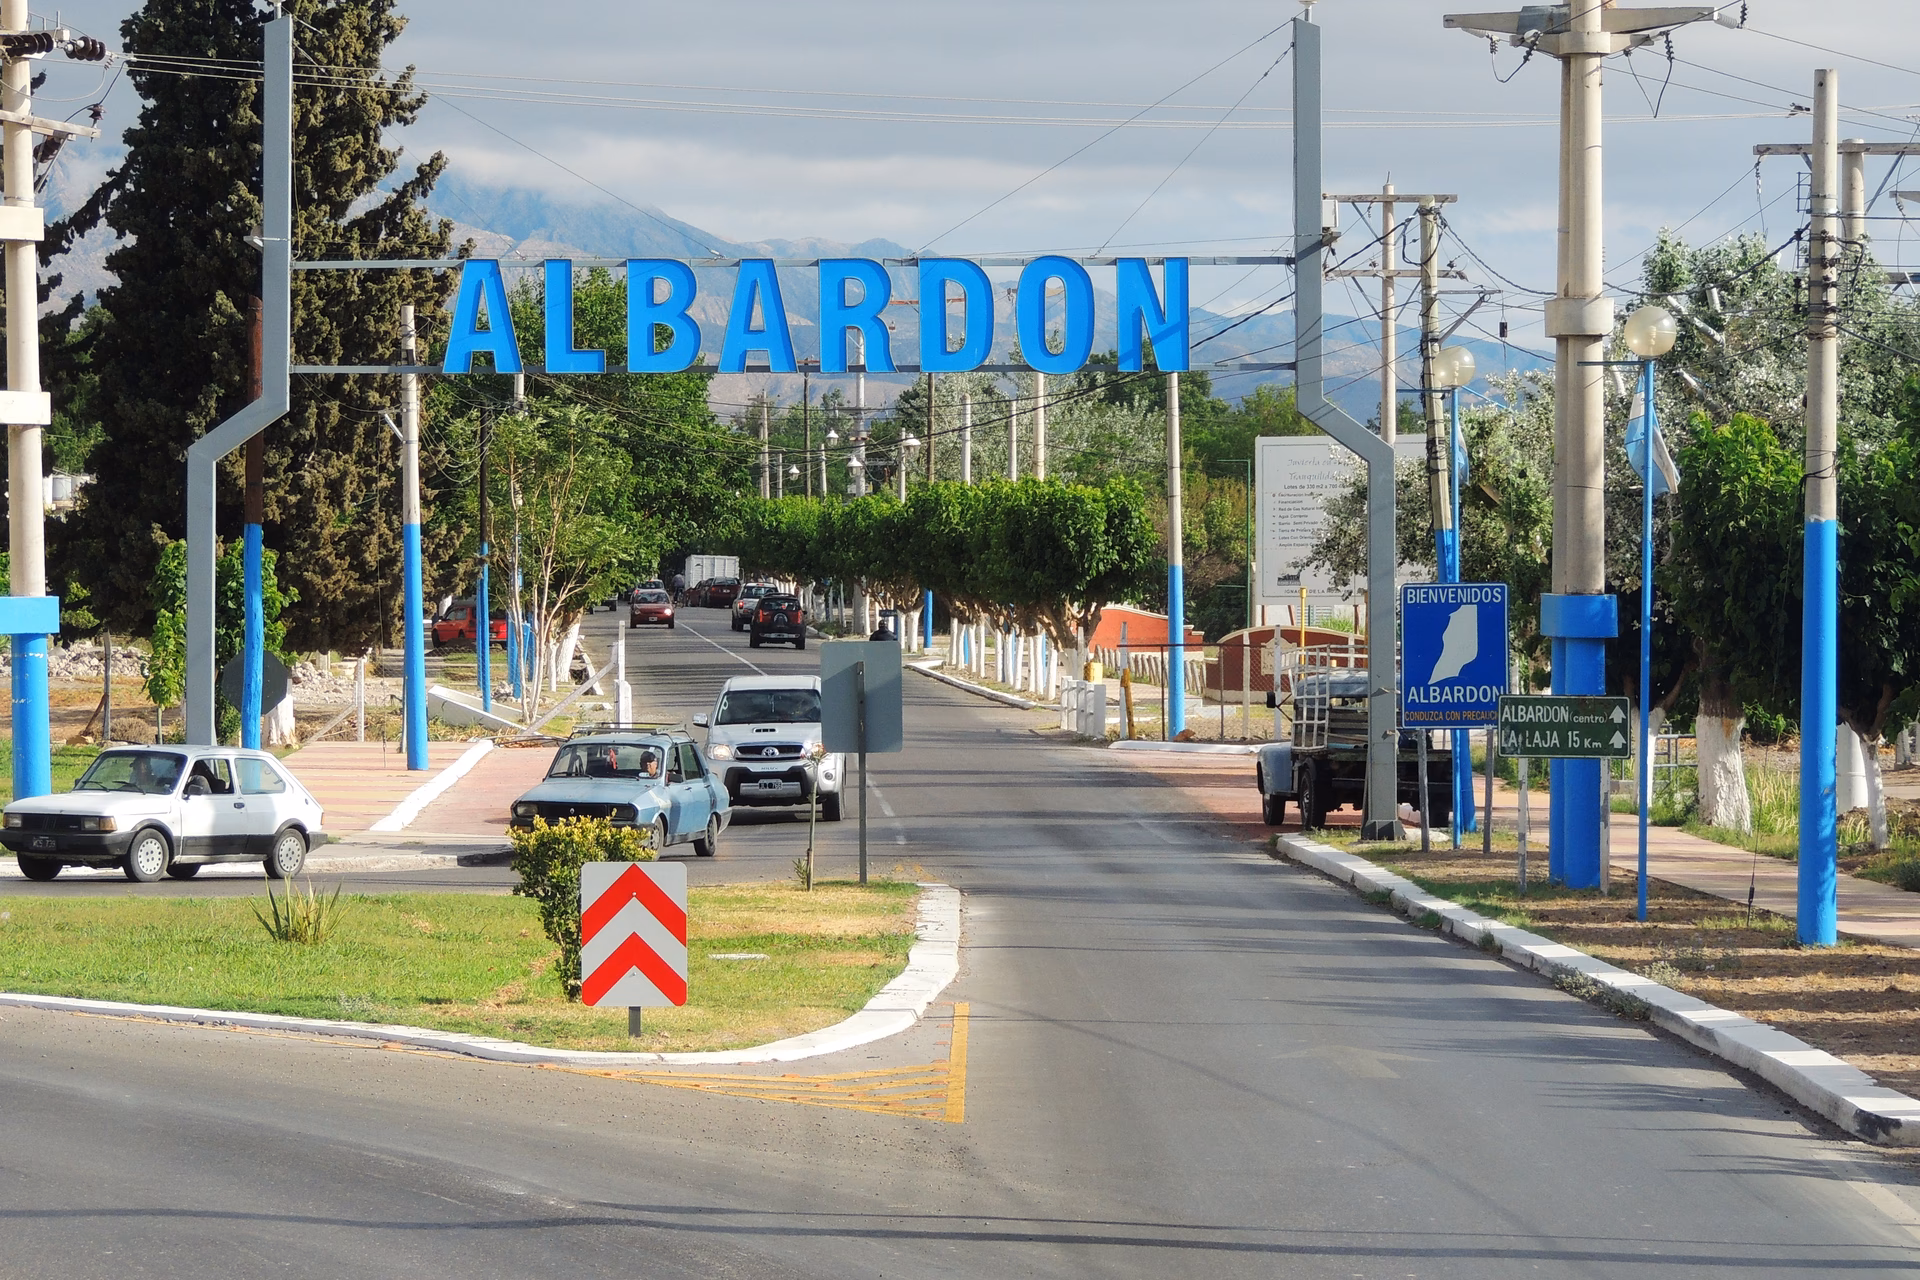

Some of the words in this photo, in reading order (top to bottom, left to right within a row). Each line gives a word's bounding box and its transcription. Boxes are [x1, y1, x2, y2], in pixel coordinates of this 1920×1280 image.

[443, 255, 1190, 374] ALBARDON
[1407, 588, 1502, 604] BIENVENIDOS
[1407, 685, 1504, 704] ALBARDON
[1404, 711, 1443, 721] CONDUZCA
[1445, 711, 1460, 721] CON
[1462, 710, 1498, 720] PRECAUCI
[1502, 705, 1569, 723] ALBARDON
[1501, 730, 1518, 748] LA
[1525, 730, 1560, 748] LAJA
[1568, 731, 1580, 748] 15
[1584, 738, 1602, 749] Km
